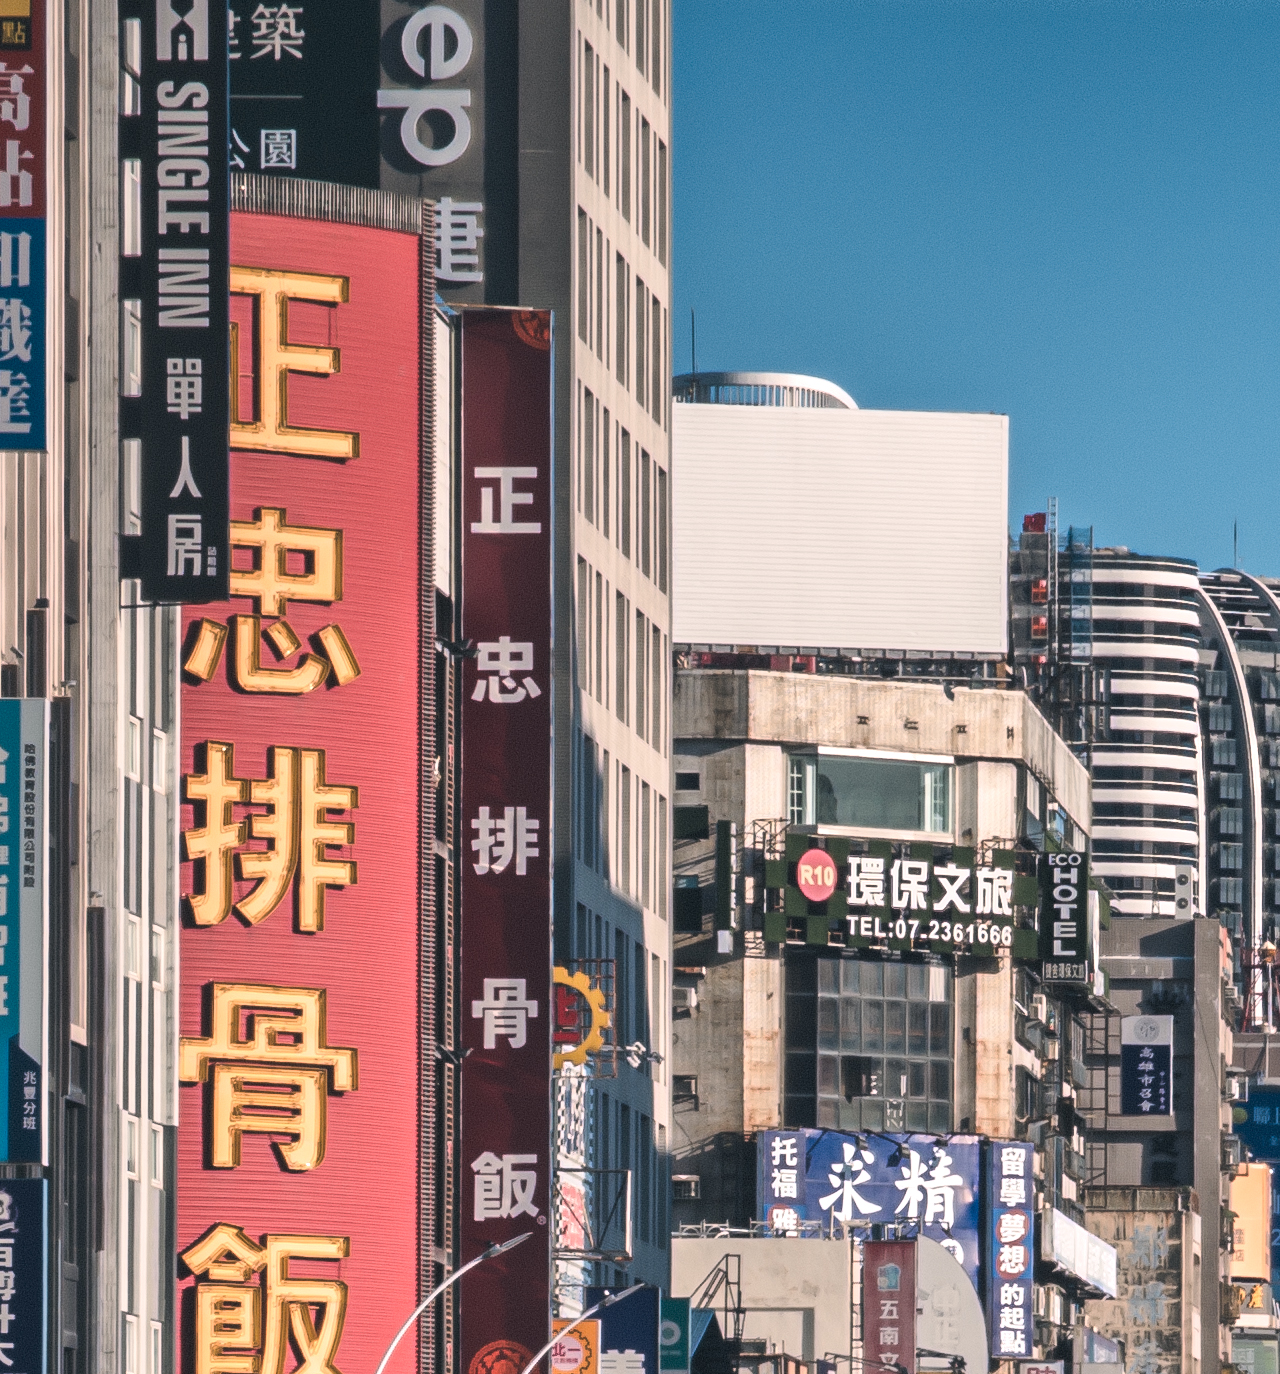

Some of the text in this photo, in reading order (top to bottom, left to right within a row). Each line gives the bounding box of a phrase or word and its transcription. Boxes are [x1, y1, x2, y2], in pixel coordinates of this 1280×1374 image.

[156, 81, 210, 327] SINGLE INN
[166, 357, 203, 577] 單人房
[470, 466, 542, 1222] 正忠排骨飯
[800, 863, 834, 887] R10
[846, 856, 1013, 916] 環保文旅
[1048, 853, 1081, 866] ECO
[1053, 867, 1078, 956] HOTEL
[771, 1136, 798, 1199] 托福
[818, 1142, 964, 1231] 求精
